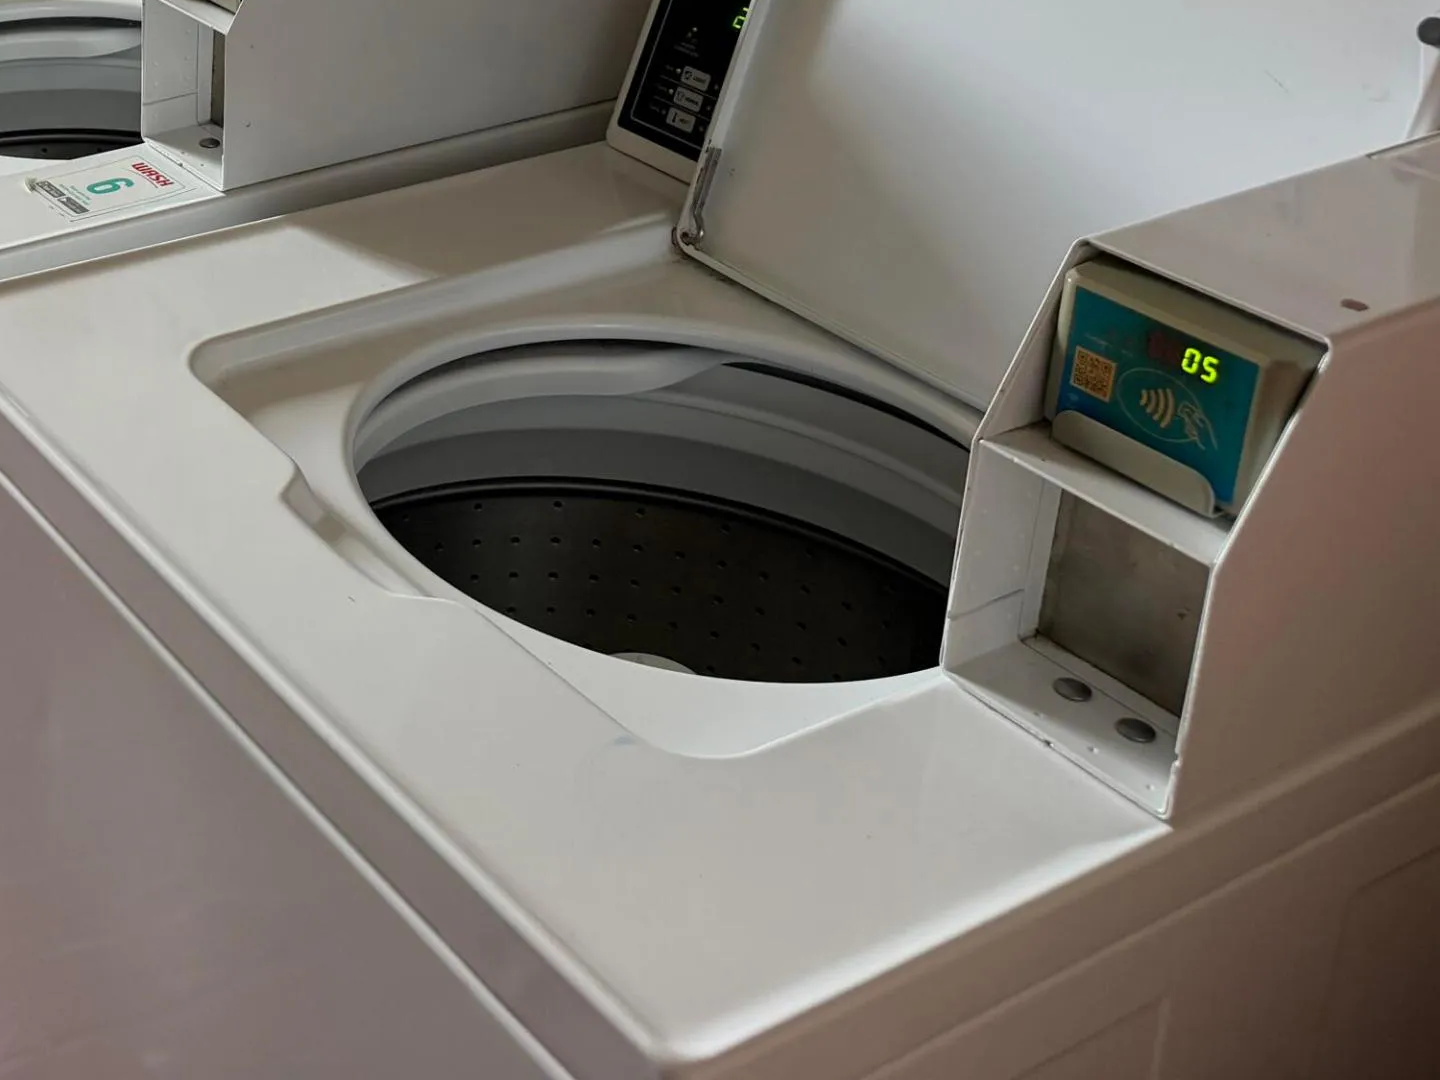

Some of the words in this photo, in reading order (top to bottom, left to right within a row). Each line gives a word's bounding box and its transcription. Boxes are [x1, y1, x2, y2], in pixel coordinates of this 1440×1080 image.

[86, 177, 135, 195] 6
[131, 161, 176, 188] WASH
[1180, 347, 1221, 384] 05
